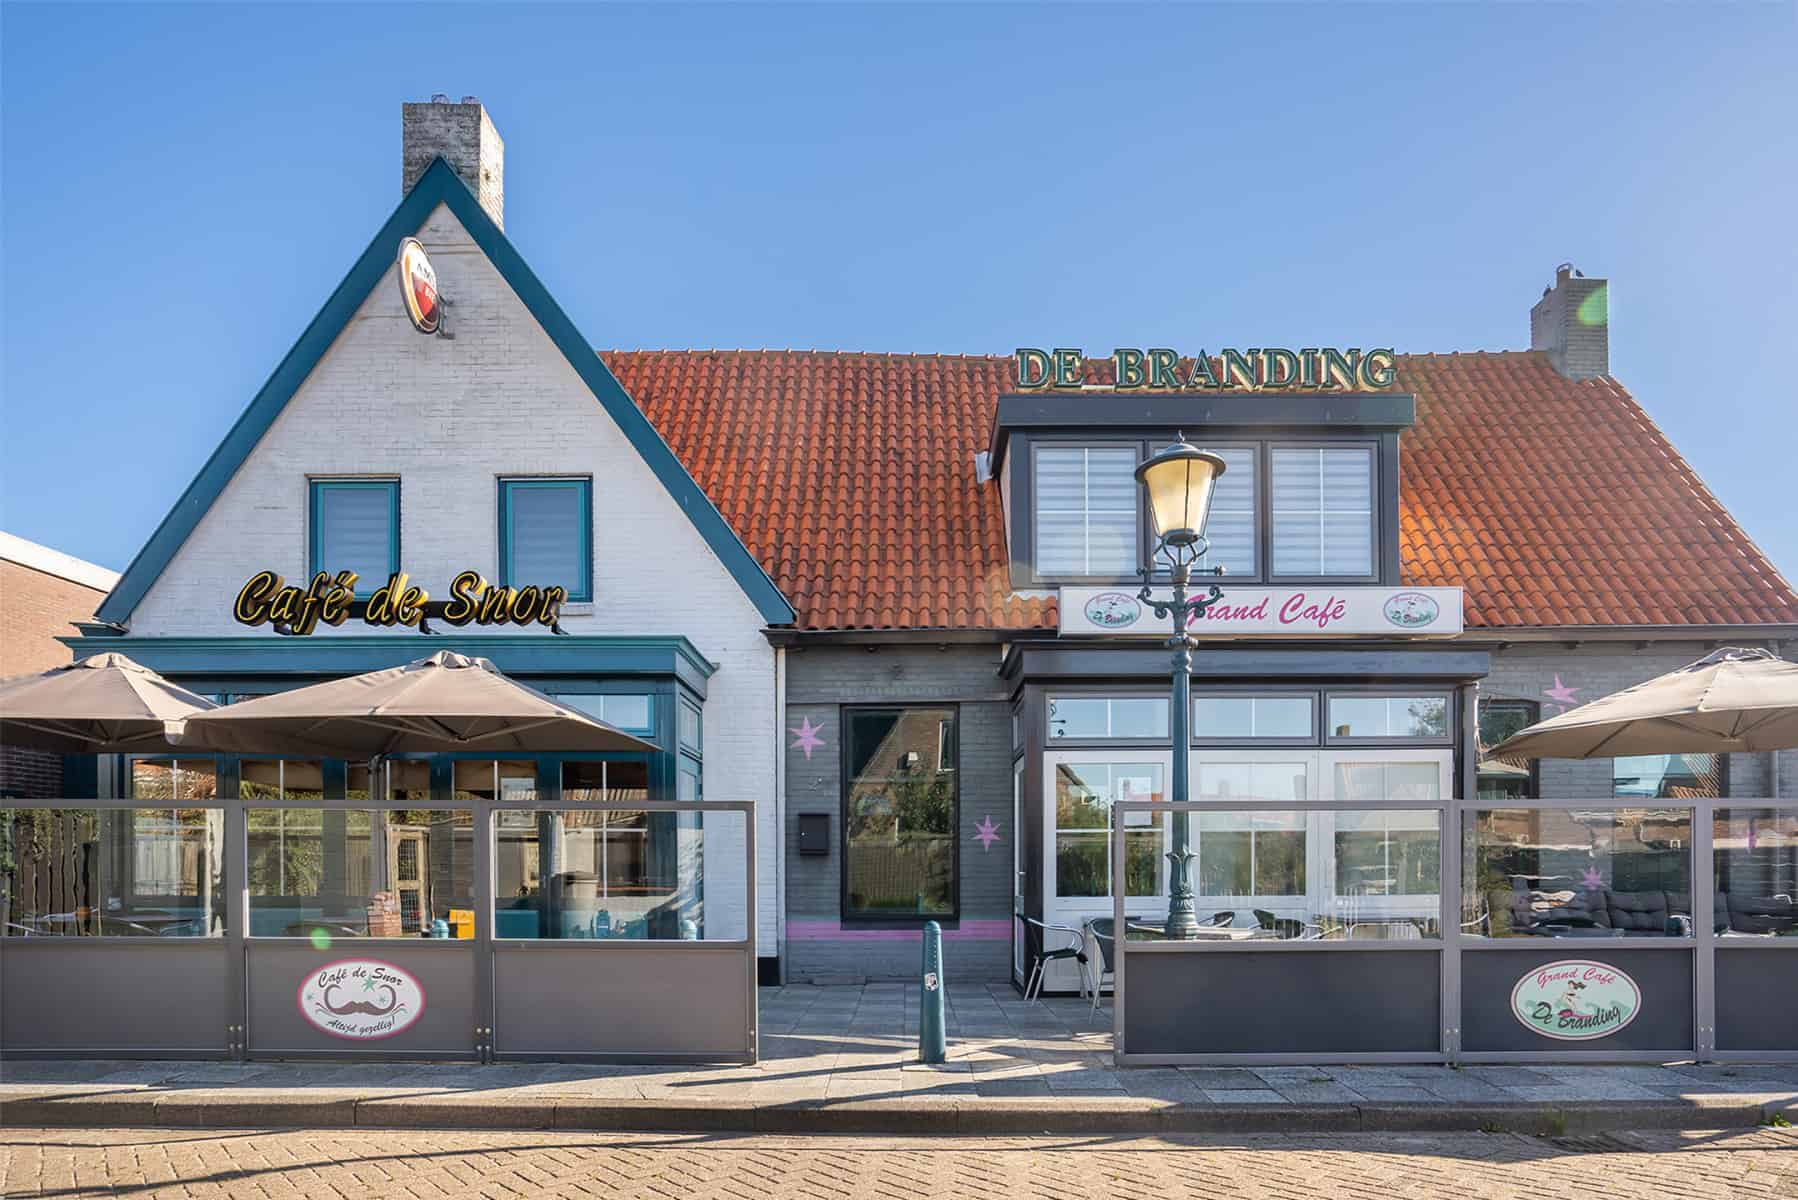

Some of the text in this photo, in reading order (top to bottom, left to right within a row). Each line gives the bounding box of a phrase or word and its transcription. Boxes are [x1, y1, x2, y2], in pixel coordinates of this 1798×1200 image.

[1016, 347, 1397, 393] DE BRANDING
[233, 571, 567, 635] Café de Snor
[1279, 593, 1346, 628] Café
[318, 966, 403, 988] Café de Snor
[1537, 967, 1617, 989] Grand Café
[1532, 1001, 1621, 1030] De Branding
